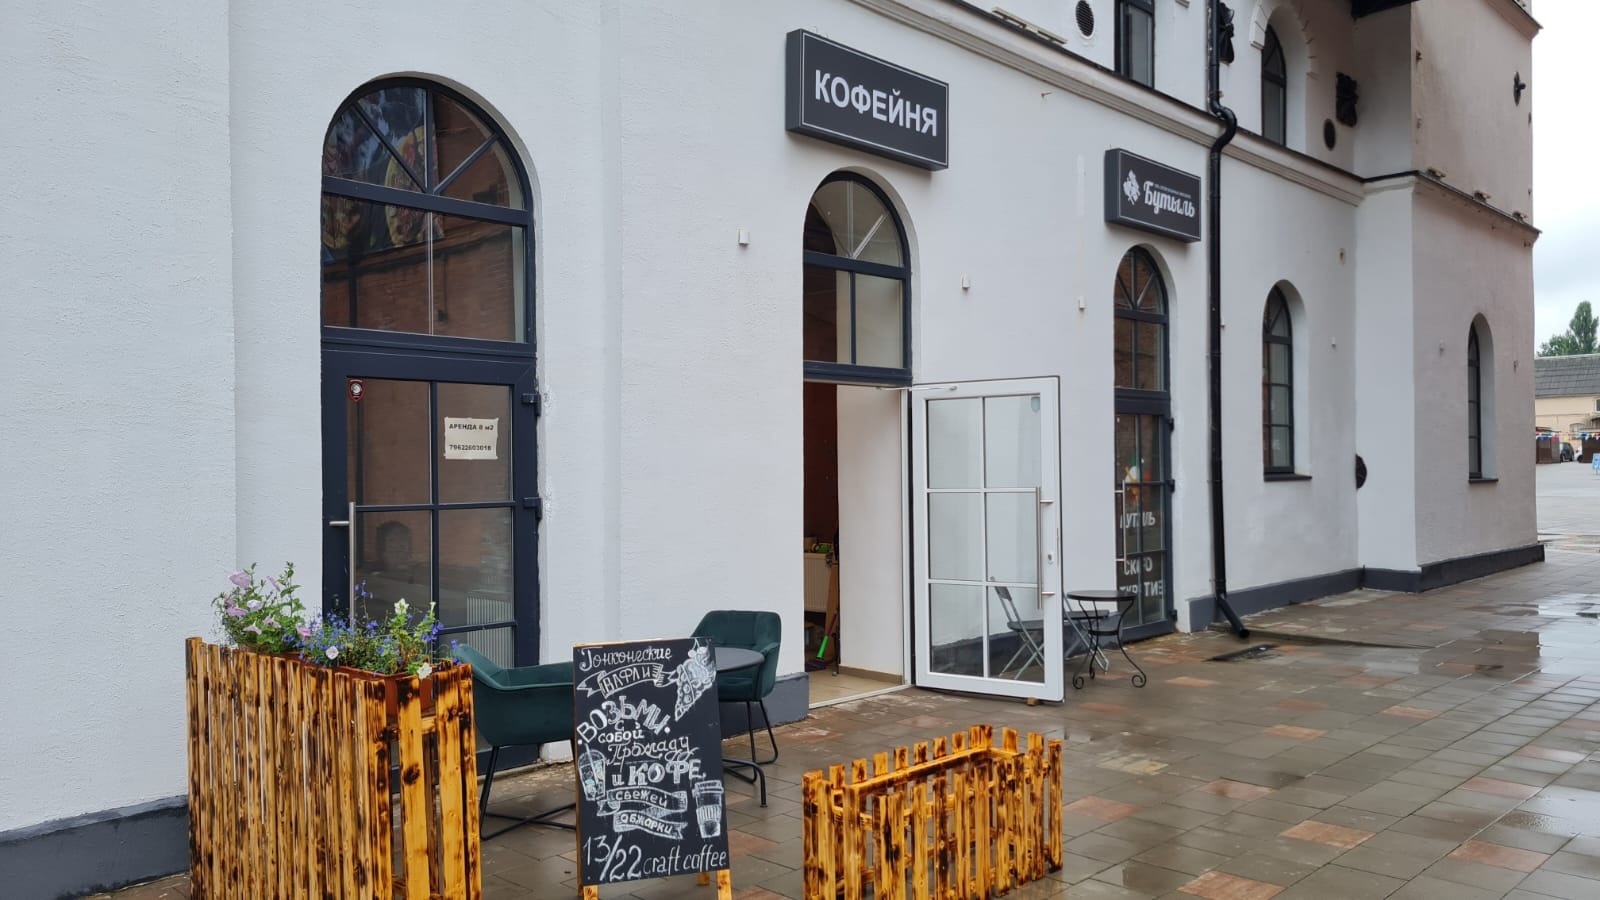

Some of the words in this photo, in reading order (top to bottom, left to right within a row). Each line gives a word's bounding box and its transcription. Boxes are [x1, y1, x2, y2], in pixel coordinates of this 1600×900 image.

[815, 69, 938, 137] КОФЕЙНЯ
[1143, 181, 1195, 217] Бутыль
[1119, 511, 1156, 529] УТЛЬ
[643, 845, 680, 876] craft
[682, 844, 727, 873] coffee
